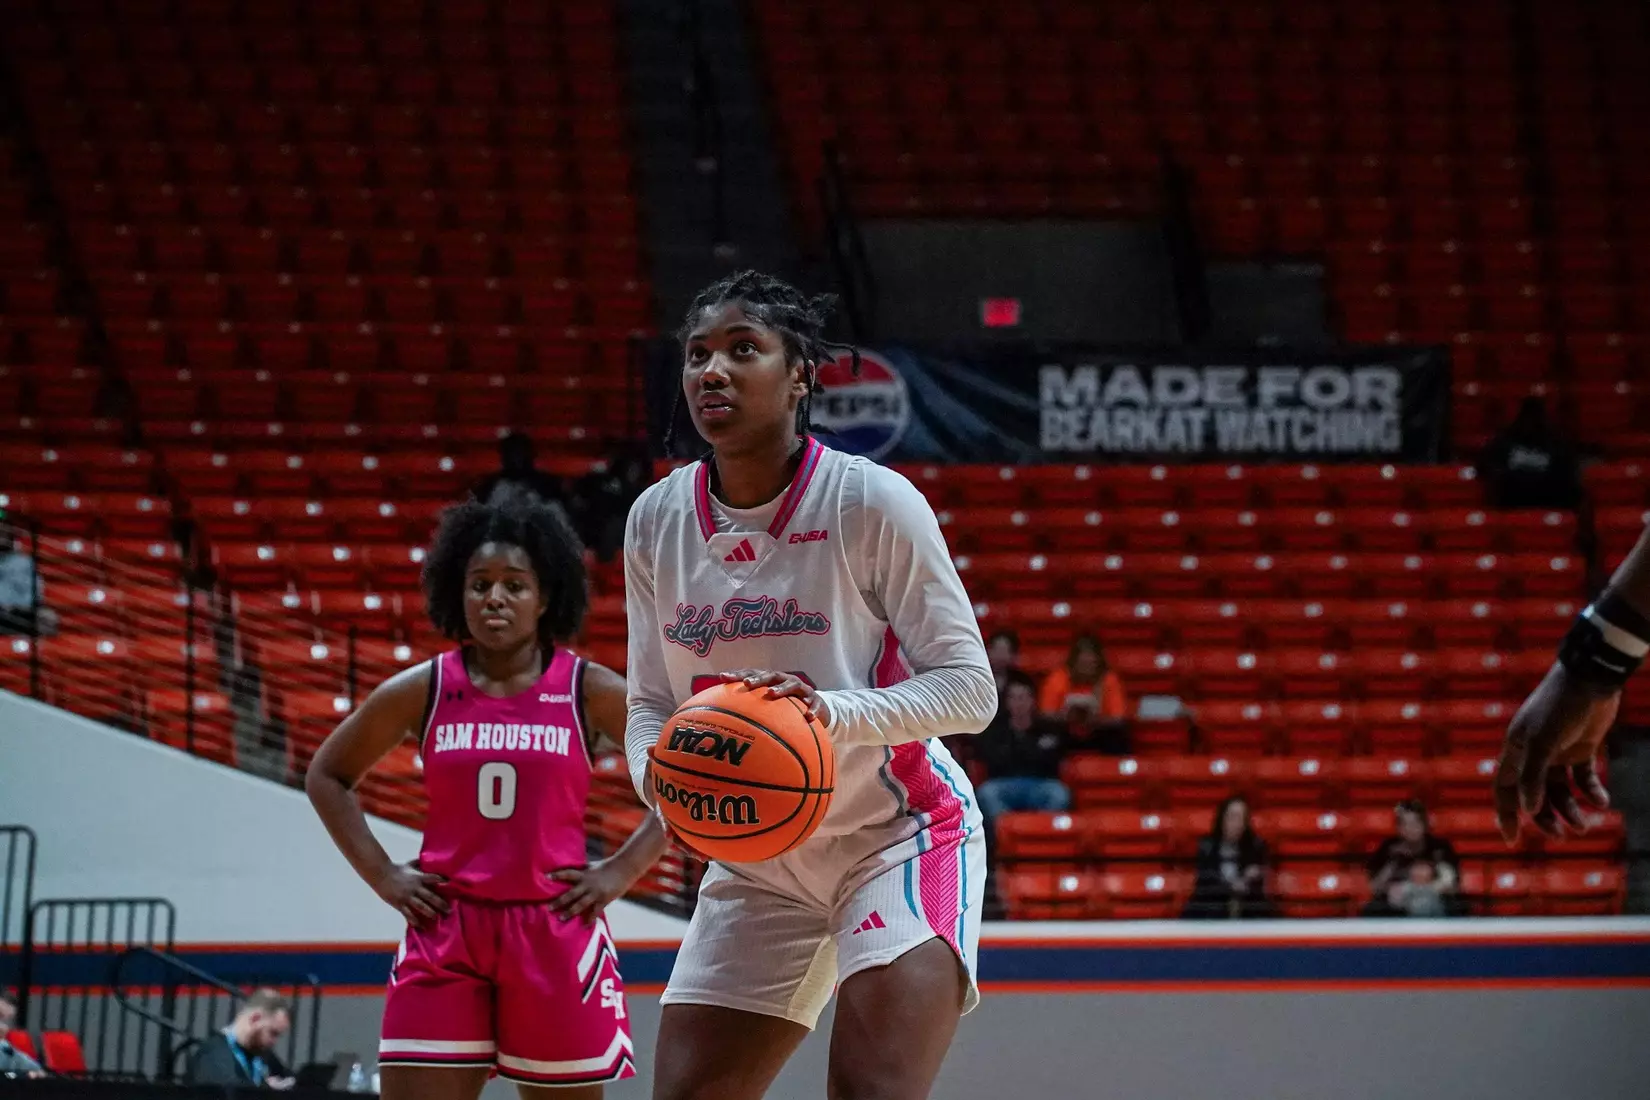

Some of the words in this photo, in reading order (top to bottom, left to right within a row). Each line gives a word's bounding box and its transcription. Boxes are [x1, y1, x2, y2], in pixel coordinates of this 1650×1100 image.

[1039, 365, 1246, 406] MADE
[1257, 366, 1401, 407] FOR
[1041, 408, 1206, 451] BEARKAT
[1216, 408, 1402, 451] WATCHING
[664, 603, 717, 657] Lady
[717, 595, 830, 642] Techsters
[434, 723, 475, 754] SAM
[476, 723, 571, 756] HOUSTON
[664, 726, 752, 767] NCAA
[478, 761, 517, 819] 0
[654, 773, 760, 825] Wilson
